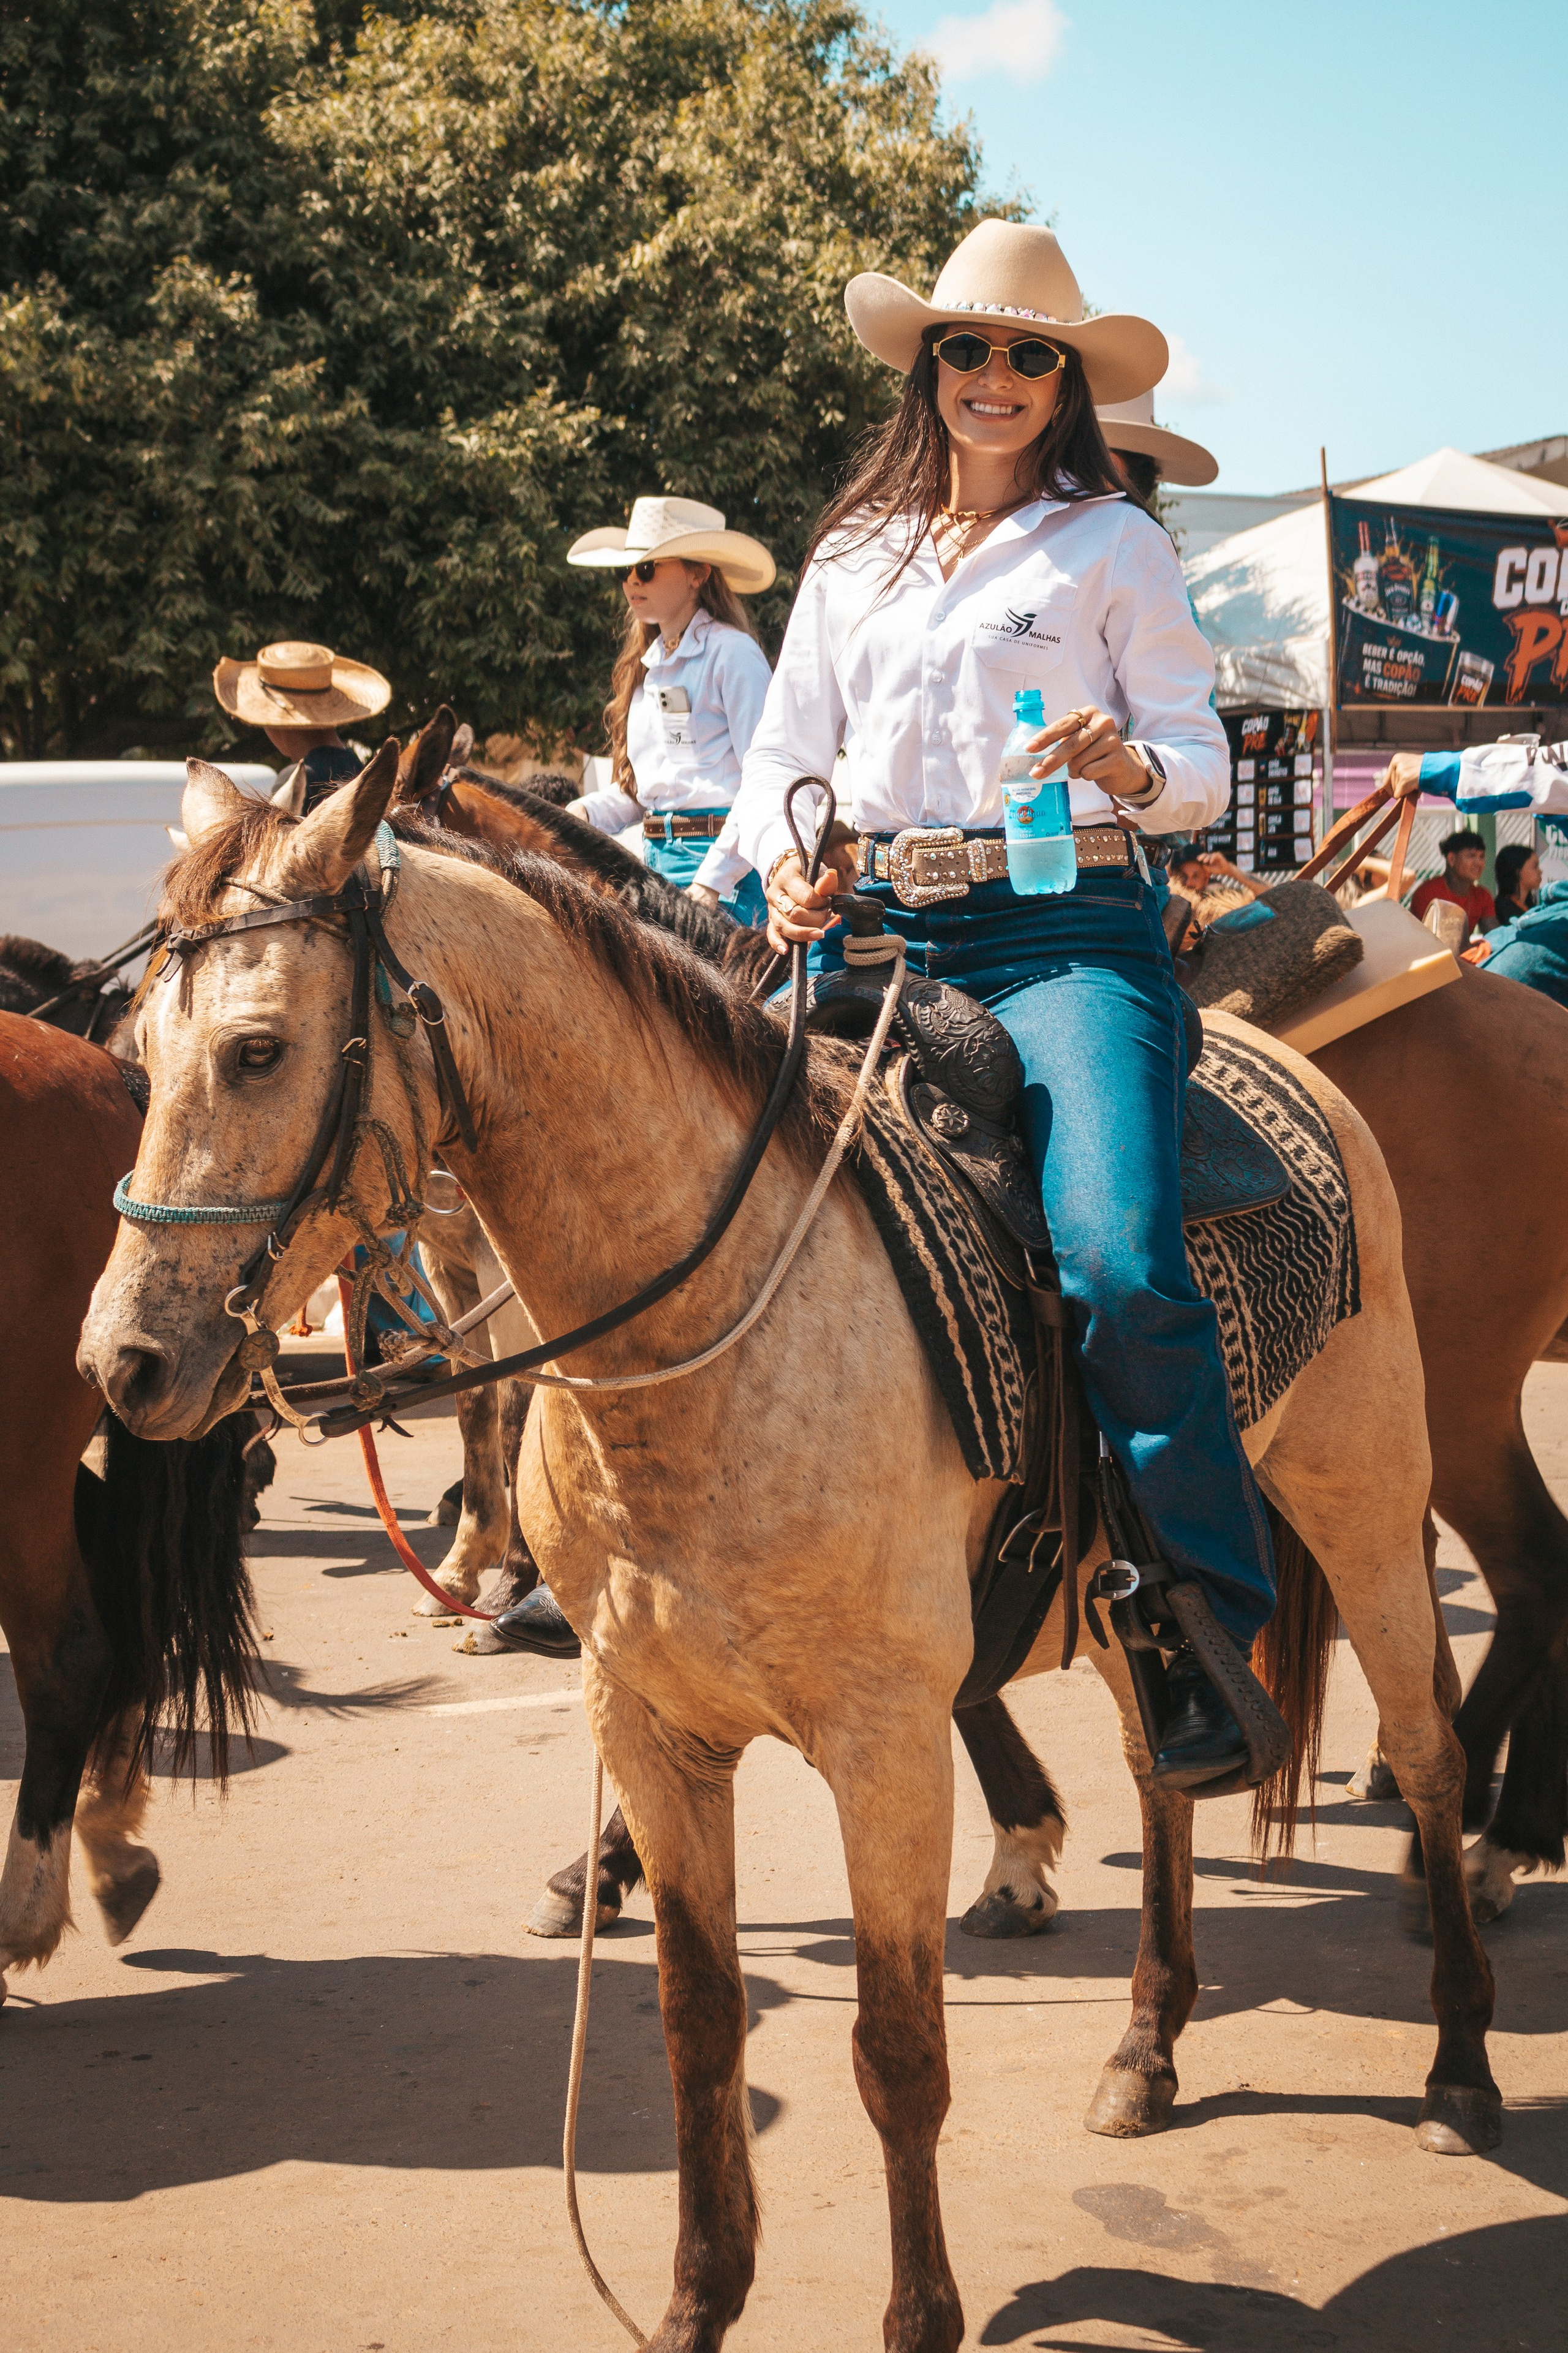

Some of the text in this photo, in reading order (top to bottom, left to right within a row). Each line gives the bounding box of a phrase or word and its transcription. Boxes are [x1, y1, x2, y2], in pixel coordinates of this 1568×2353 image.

[979, 622, 1061, 644] AZULÃO MALHAS
[1022, 641, 1049, 651] UNIFORMES
[1363, 658, 1382, 675] MAS
